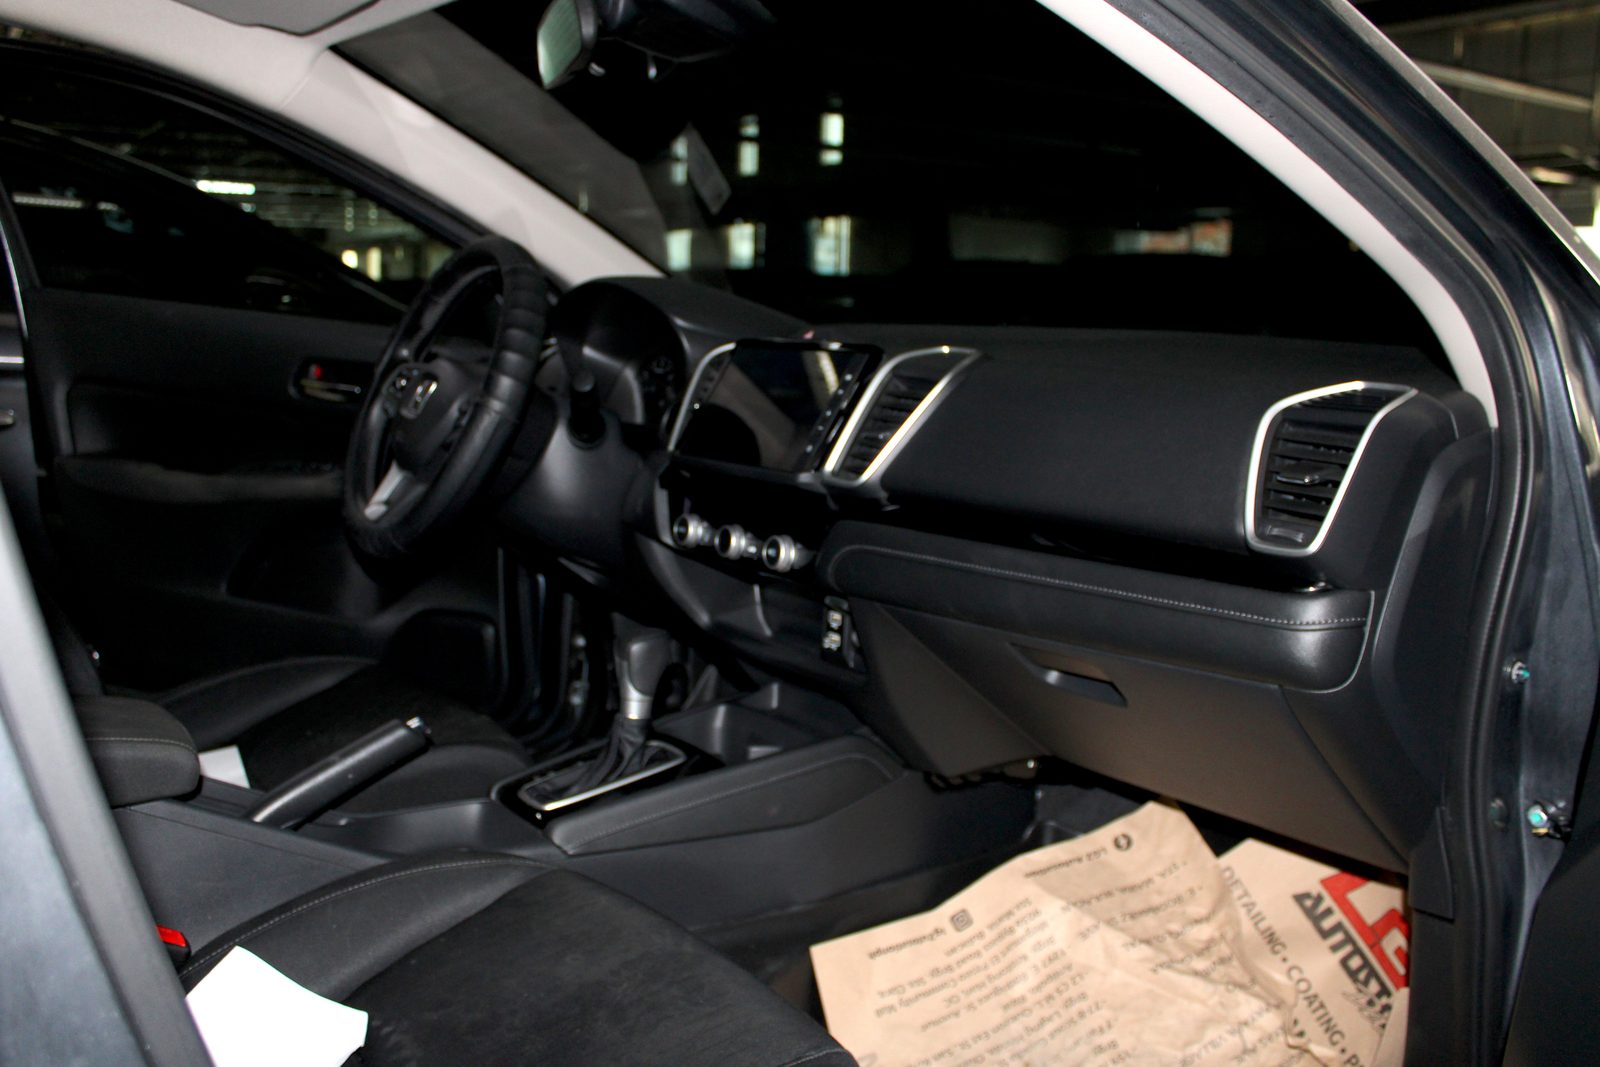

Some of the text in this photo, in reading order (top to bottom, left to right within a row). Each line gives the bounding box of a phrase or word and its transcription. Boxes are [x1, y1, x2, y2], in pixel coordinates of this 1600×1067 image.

[1222, 866, 1287, 955] DETAILING
[1292, 892, 1392, 1014] AUTOST
[1286, 965, 1346, 1046] COATING
